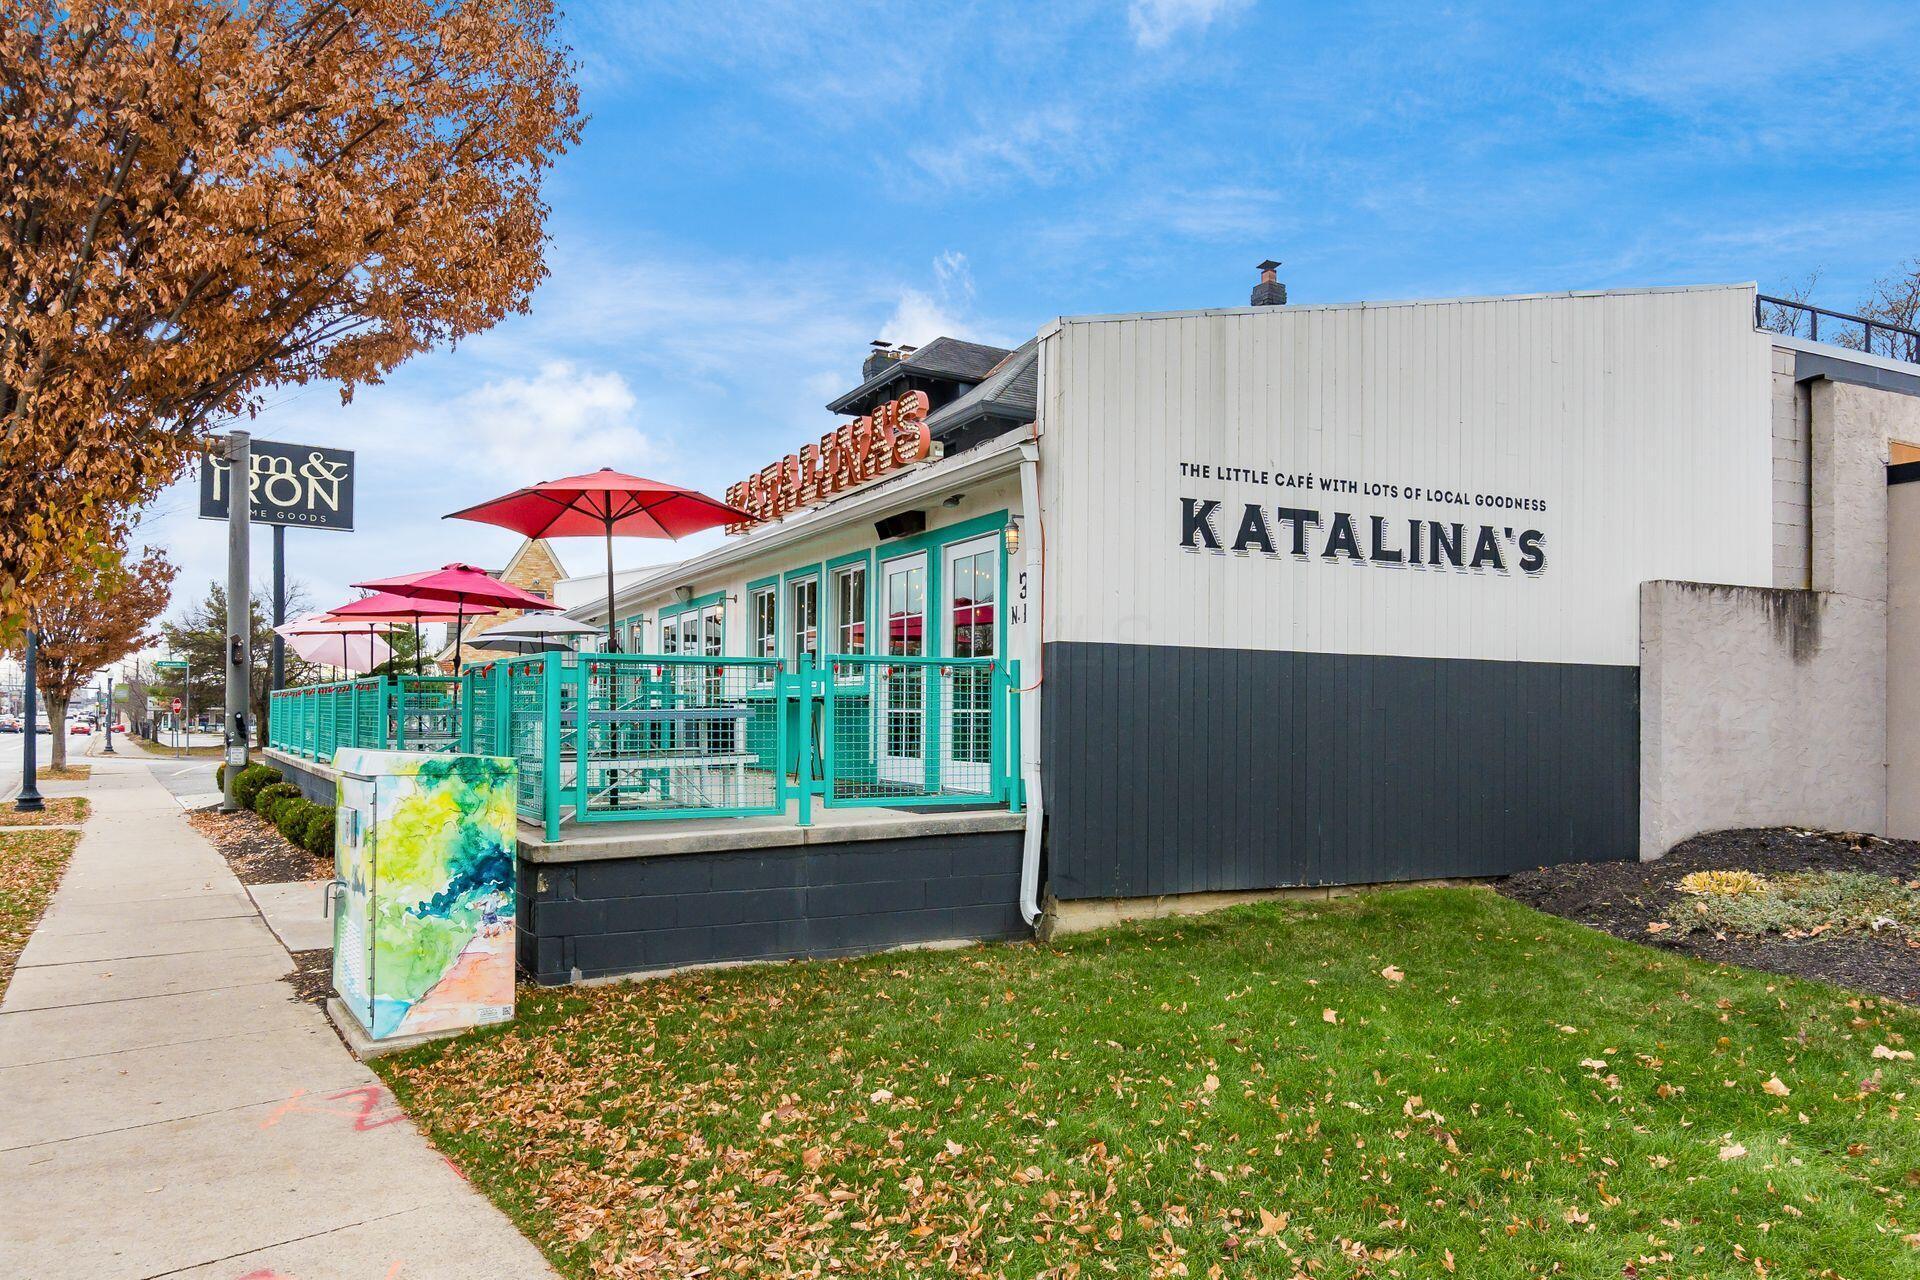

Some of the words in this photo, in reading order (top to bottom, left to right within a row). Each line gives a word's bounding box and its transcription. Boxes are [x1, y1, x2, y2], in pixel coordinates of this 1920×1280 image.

[725, 389, 931, 537] KATALINA'S
[1179, 462, 1210, 479] THE
[1217, 466, 1269, 485] LITTLE
[1274, 472, 1314, 490] CAFÉ
[1319, 477, 1358, 494] WITH
[1364, 482, 1399, 499] LOTS
[1403, 486, 1422, 500] OF
[1426, 489, 1470, 506] LOCAL
[1475, 494, 1547, 512] GOODNESS
[276, 511, 327, 523] GOODS
[1179, 497, 1547, 579] KATALINA'S
